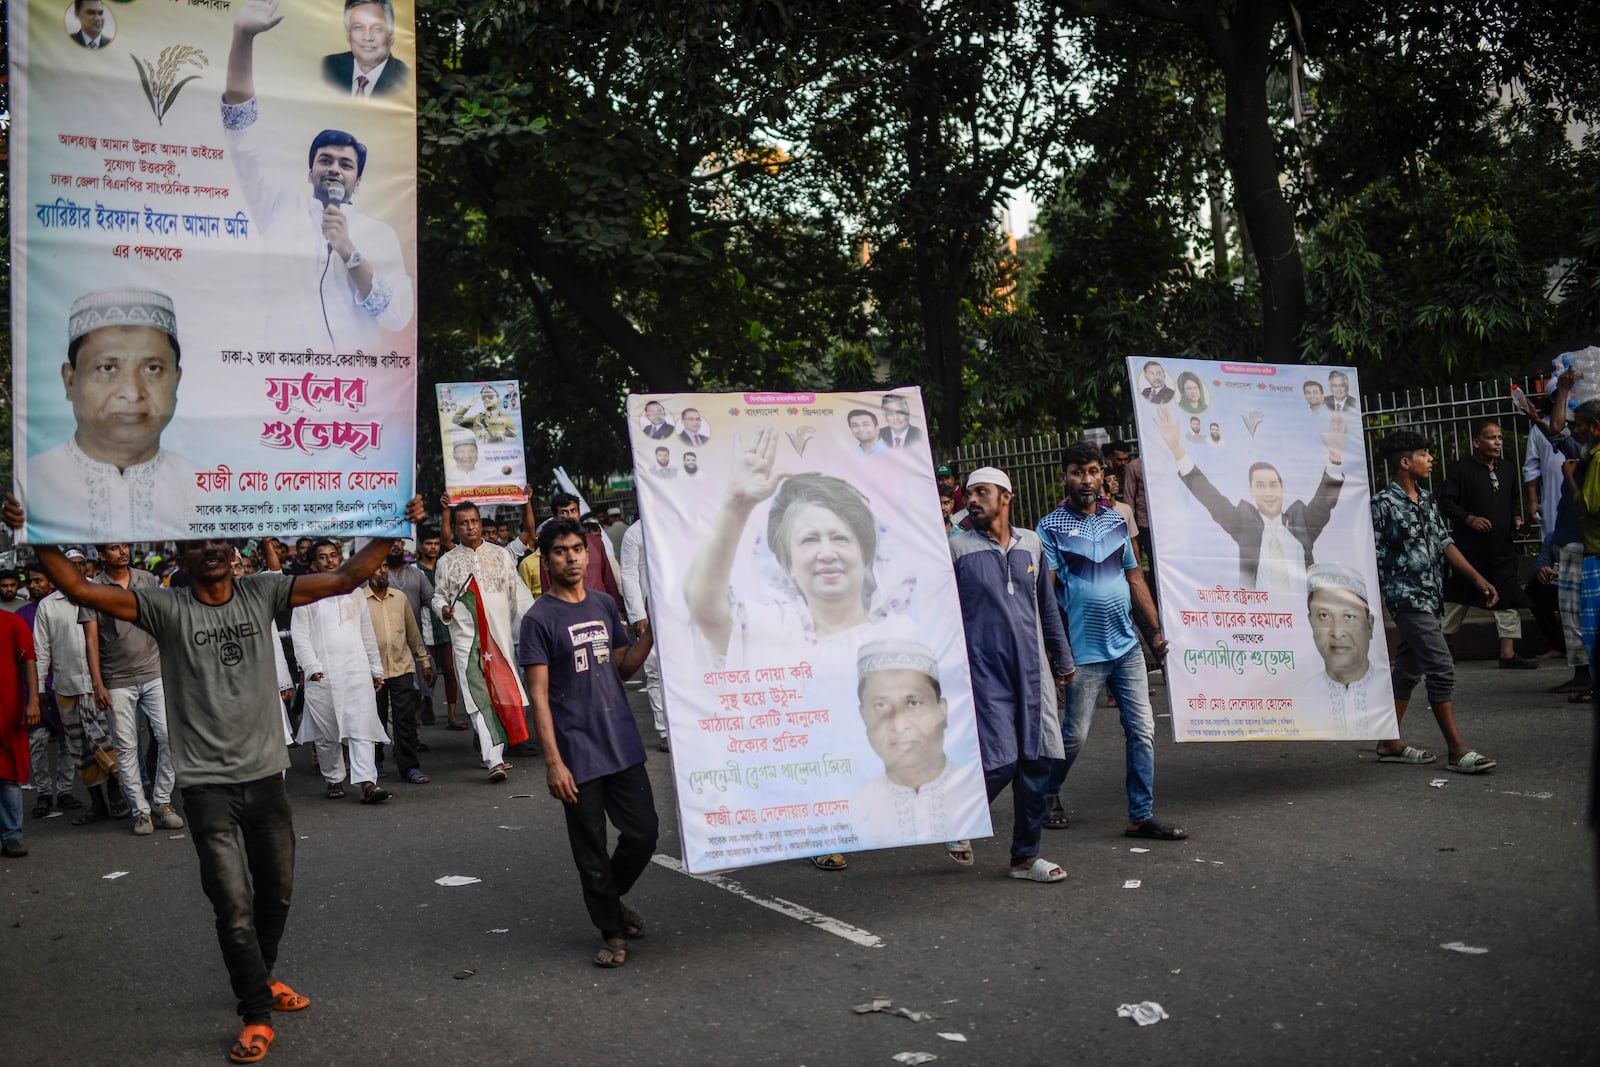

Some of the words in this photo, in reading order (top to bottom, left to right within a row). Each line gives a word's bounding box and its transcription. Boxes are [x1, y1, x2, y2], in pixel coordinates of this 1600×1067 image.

[58, 134, 97, 151] আলহাজ্ব
[101, 138, 129, 151] আমান
[132, 139, 157, 155] উল্লাহ
[160, 143, 187, 157] আমান
[191, 145, 224, 160] ভাইয়ের
[104, 159, 135, 173] সুযোগ্য
[50, 174, 72, 188] ঢাকা
[76, 177, 99, 189] জেলা
[103, 176, 142, 192] বিএনপির
[146, 180, 190, 195] সাংগঠনিক
[193, 186, 229, 199] সম্পাদক
[36, 198, 91, 230] ব্যারিষ্টার
[95, 201, 139, 233] ইরফান
[144, 204, 177, 235] ইবনে
[182, 214, 220, 238] আমান
[224, 211, 248, 239] অমি
[113, 244, 129, 260] এর
[134, 245, 183, 261] পক্ষথেকে
[221, 350, 253, 365] ঢাকা-২
[257, 352, 275, 366] তথা
[381, 351, 411, 369] বাসীকে
[264, 372, 367, 412] ফুলের
[260, 416, 381, 458] শুভেচ্ছা
[195, 464, 233, 492] হাজী
[238, 472, 268, 492] মোঃ
[275, 472, 342, 492] দেলোয়ার
[347, 472, 399, 492] হোসেন
[196, 504, 222, 516] সাবেক
[226, 501, 274, 515] সহ-সভাপতি
[282, 503, 300, 515] ঢাকা
[303, 503, 333, 514] মহানগর
[336, 500, 364, 513] বিএনপি
[368, 500, 397, 515] (দক্ষিণ)
[189, 521, 215, 534] সাবেক
[258, 522, 263, 531] ও
[266, 518, 298, 531] সভাপতি
[356, 519, 372, 529] থানা
[376, 517, 403, 529] বিএনপি
[1197, 585, 1230, 603] আগামীর
[1232, 588, 1268, 605] রাষ্ট্রনায়ক
[1180, 611, 1208, 628] জনাব
[1211, 612, 1246, 628] তারেক
[1248, 613, 1293, 628] রহমানের
[194, 622, 258, 645] CHANEL
[1184, 640, 1246, 675] দেশবাসীকে
[1249, 650, 1295, 675] শুভেচ্ছা
[703, 670, 750, 686] প্রাণভরে
[755, 667, 784, 682] দোয়া
[788, 661, 812, 680] করি
[719, 694, 740, 711] সুস্থ
[742, 691, 765, 706] হয়ে
[1187, 693, 1206, 711] হাজী
[1210, 699, 1225, 711] মোঃ
[1228, 698, 1263, 711] দেলোয়ার
[1266, 698, 1293, 711] হোসেন
[698, 712, 744, 733] আঠারো
[749, 708, 781, 730] কোটি
[785, 709, 829, 728] মানুষের
[728, 735, 768, 753] ঐক্যের
[773, 731, 808, 752] প্রতিক
[689, 759, 741, 795] দেশনেত্রী
[746, 765, 777, 790] বেগম
[781, 761, 821, 785] খালেদা
[822, 752, 852, 777] জিয়া
[704, 805, 730, 828] হাজী
[736, 809, 757, 825] মোঃ
[761, 804, 808, 823] দেলোয়ার
[813, 799, 849, 817] হোসেন
